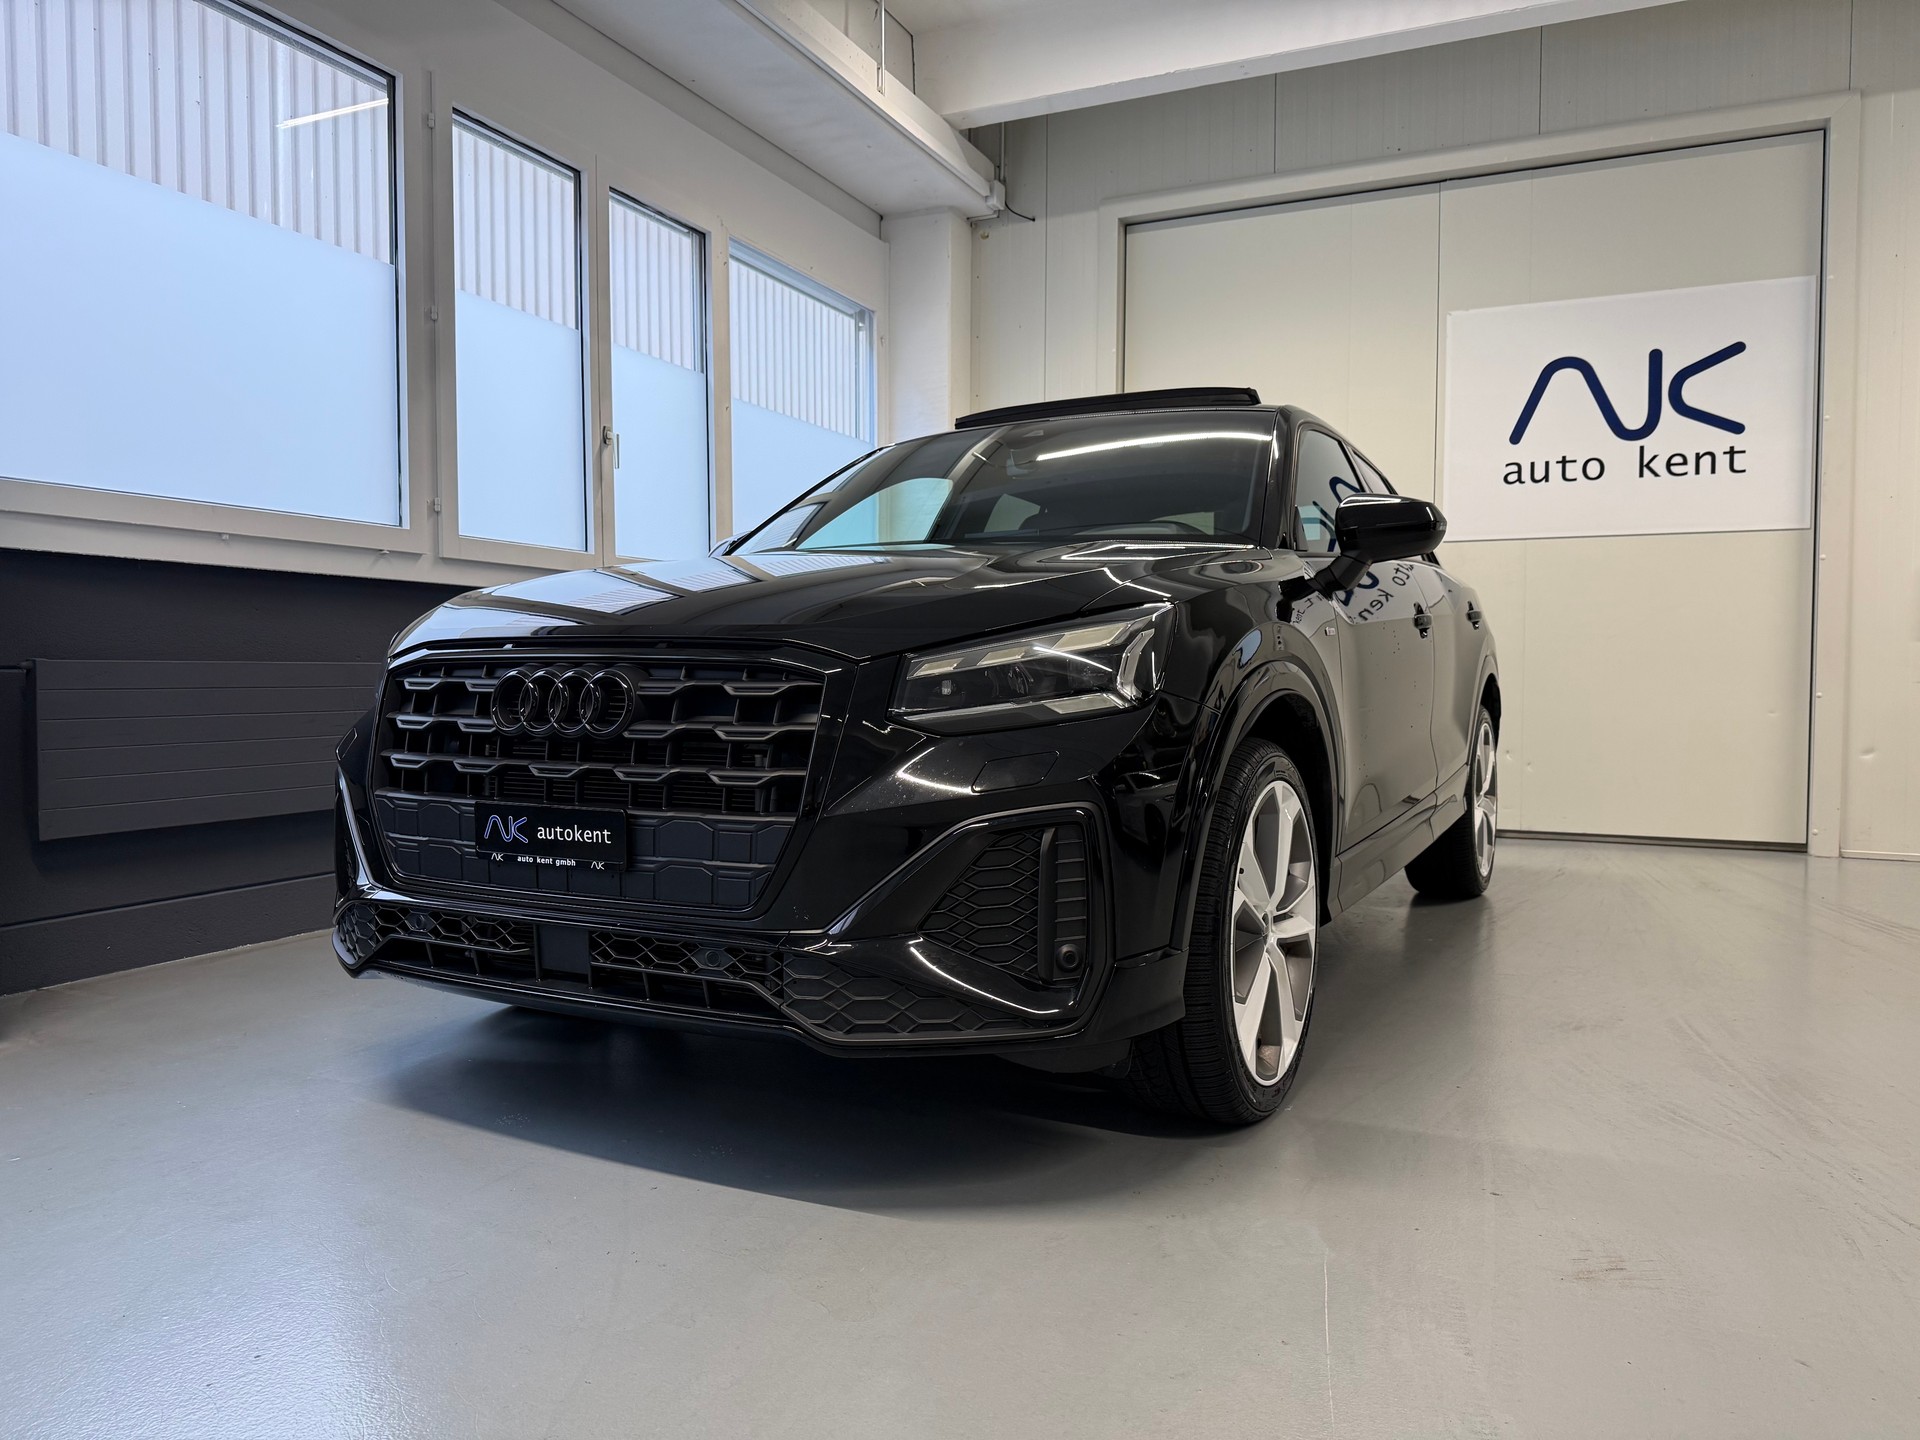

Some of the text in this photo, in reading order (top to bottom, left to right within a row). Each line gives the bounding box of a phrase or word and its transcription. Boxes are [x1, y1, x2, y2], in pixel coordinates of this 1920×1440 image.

[1502, 445, 1747, 485] auto kent
[537, 824, 612, 845] autokent
[517, 855, 534, 863] auto
[536, 856, 553, 865] kent
[555, 858, 576, 867] gmbh
